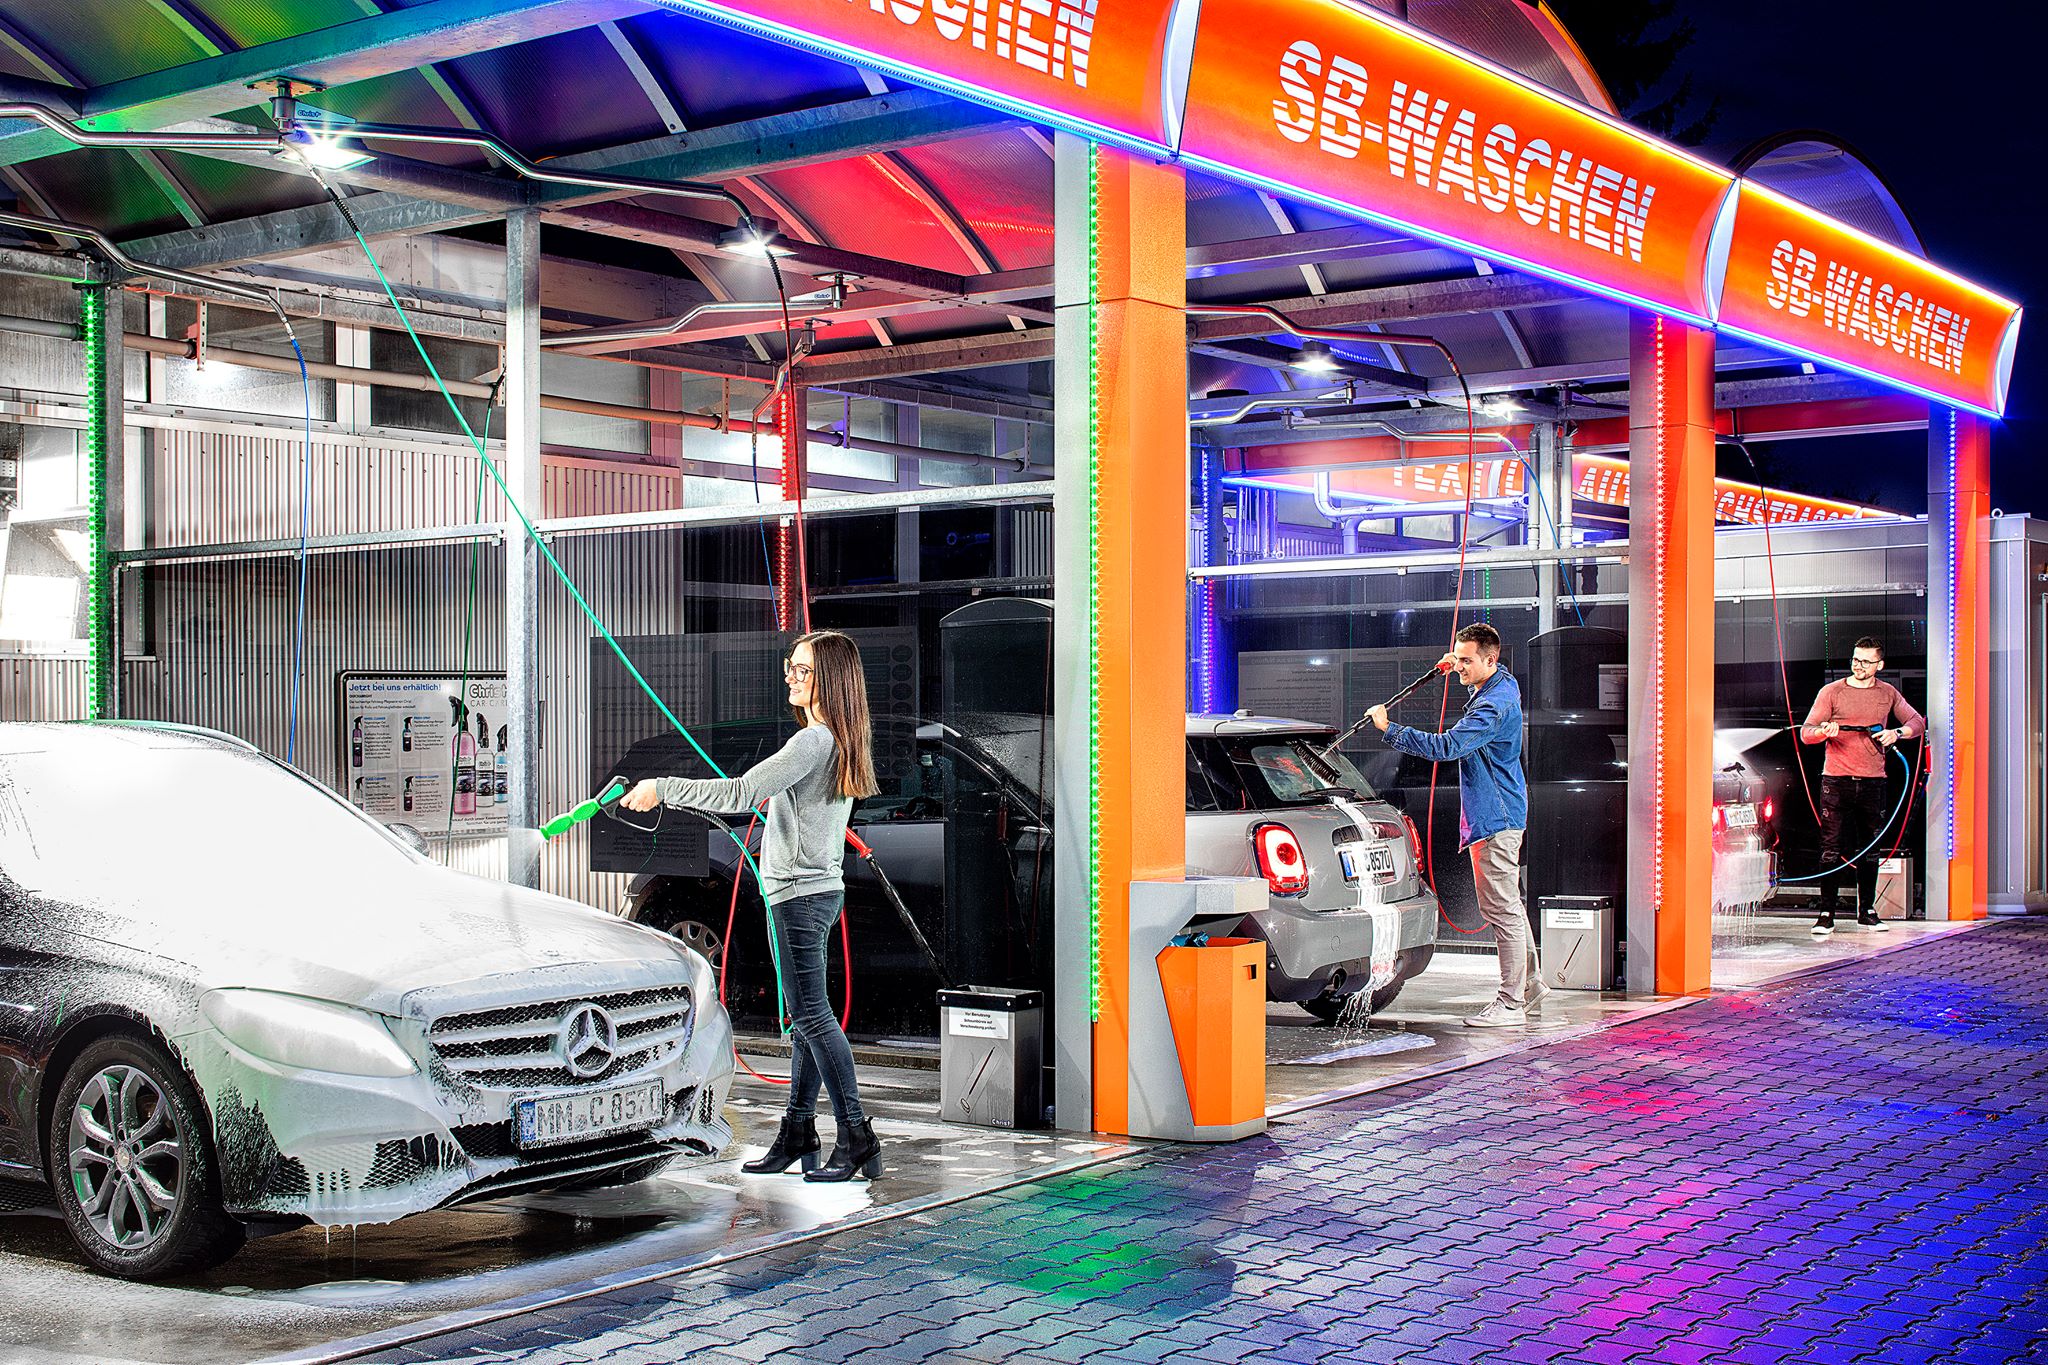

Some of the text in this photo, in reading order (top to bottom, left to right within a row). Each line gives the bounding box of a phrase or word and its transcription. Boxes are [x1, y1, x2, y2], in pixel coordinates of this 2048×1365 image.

[1272, 40, 1656, 263] SB-WASCHEN
[1766, 239, 1971, 375] SB-WASCHEN
[349, 683, 370, 692] Jetzt
[373, 683, 385, 691] bei
[403, 683, 441, 691] erhältlich!
[469, 684, 507, 698] Christ
